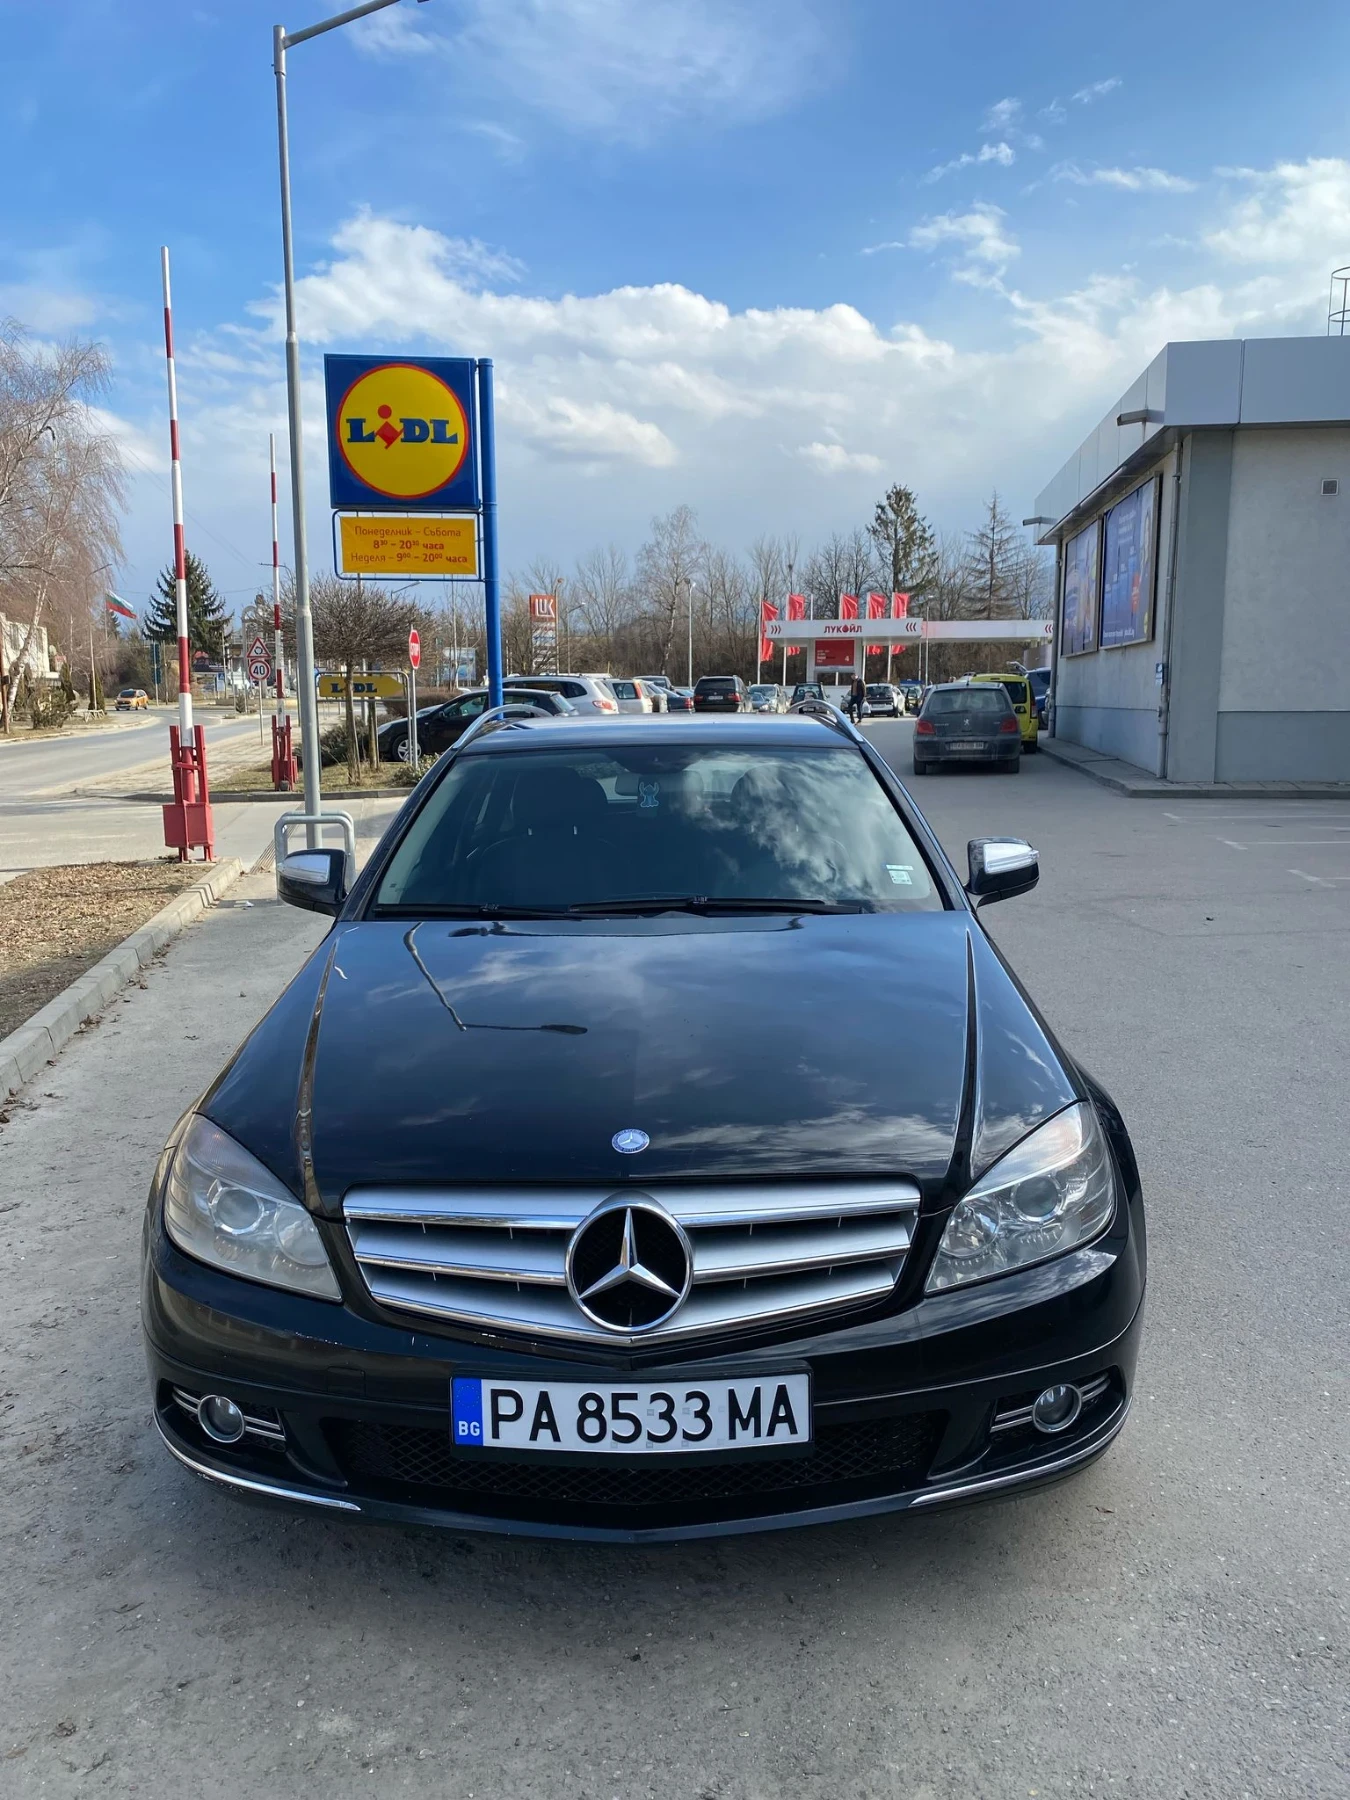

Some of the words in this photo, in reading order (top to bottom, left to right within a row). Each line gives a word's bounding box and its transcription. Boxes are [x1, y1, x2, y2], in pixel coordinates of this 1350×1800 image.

[354, 525, 413, 539] Понеделник
[423, 526, 462, 538] Събота
[422, 542, 445, 550] часа
[350, 552, 386, 564] Неделя
[445, 554, 468, 563] часа
[253, 665, 265, 676] 40
[330, 682, 378, 694] LDL
[490, 1388, 561, 1443] PA
[576, 1390, 714, 1444] 8533
[728, 1384, 798, 1441] MA
[458, 1420, 481, 1437] BG
